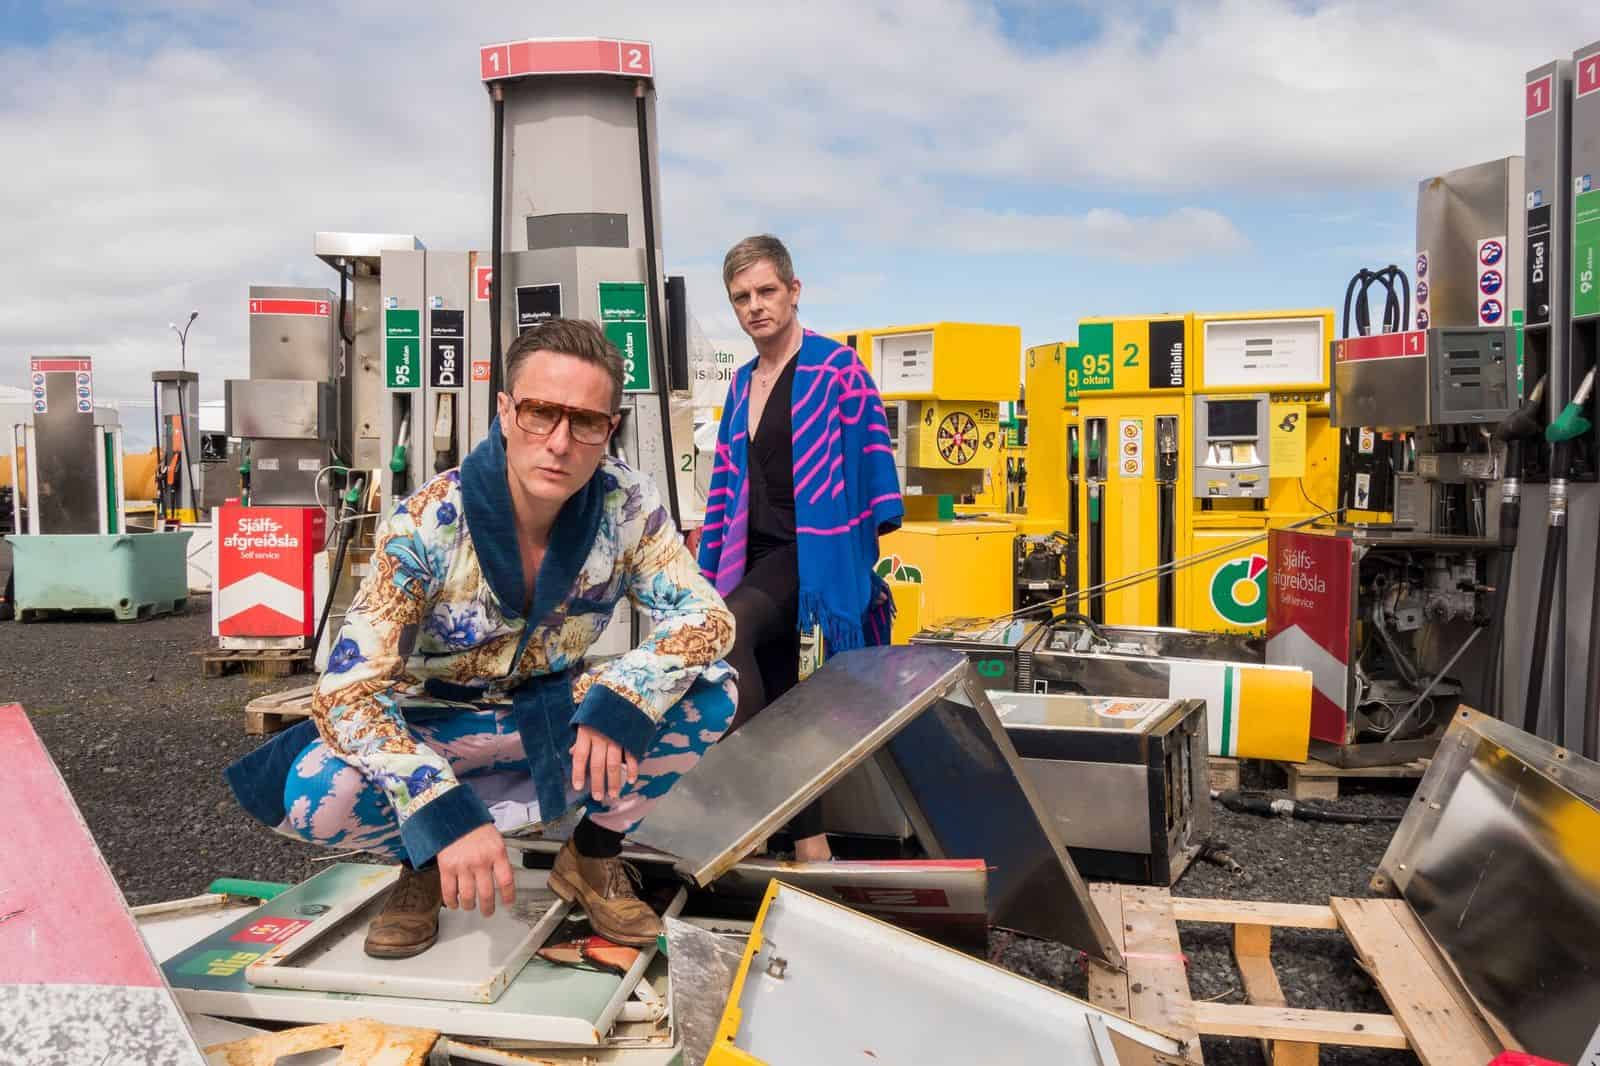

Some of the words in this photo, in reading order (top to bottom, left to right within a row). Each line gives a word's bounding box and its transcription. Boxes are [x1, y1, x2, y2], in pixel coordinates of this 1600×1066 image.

[489, 51, 499, 72] 1
[628, 49, 643, 69] 2
[1586, 62, 1597, 84] 1
[1533, 87, 1542, 107] 1
[1580, 271, 1593, 294] 95
[251, 302, 257, 312] 1
[320, 304, 328, 314] 2
[1410, 335, 1418, 352] 1
[439, 345, 455, 385] Dísel
[1082, 354, 1111, 375] 95
[1123, 343, 1139, 368] 2
[396, 365, 410, 385] 95
[1068, 368, 1079, 387] 9
[1082, 375, 1110, 385] oktan
[681, 453, 693, 472] 2
[238, 518, 283, 535] Sjálfs-
[224, 533, 299, 551] afgreiðsla
[1283, 549, 1317, 570] Sjálfs-
